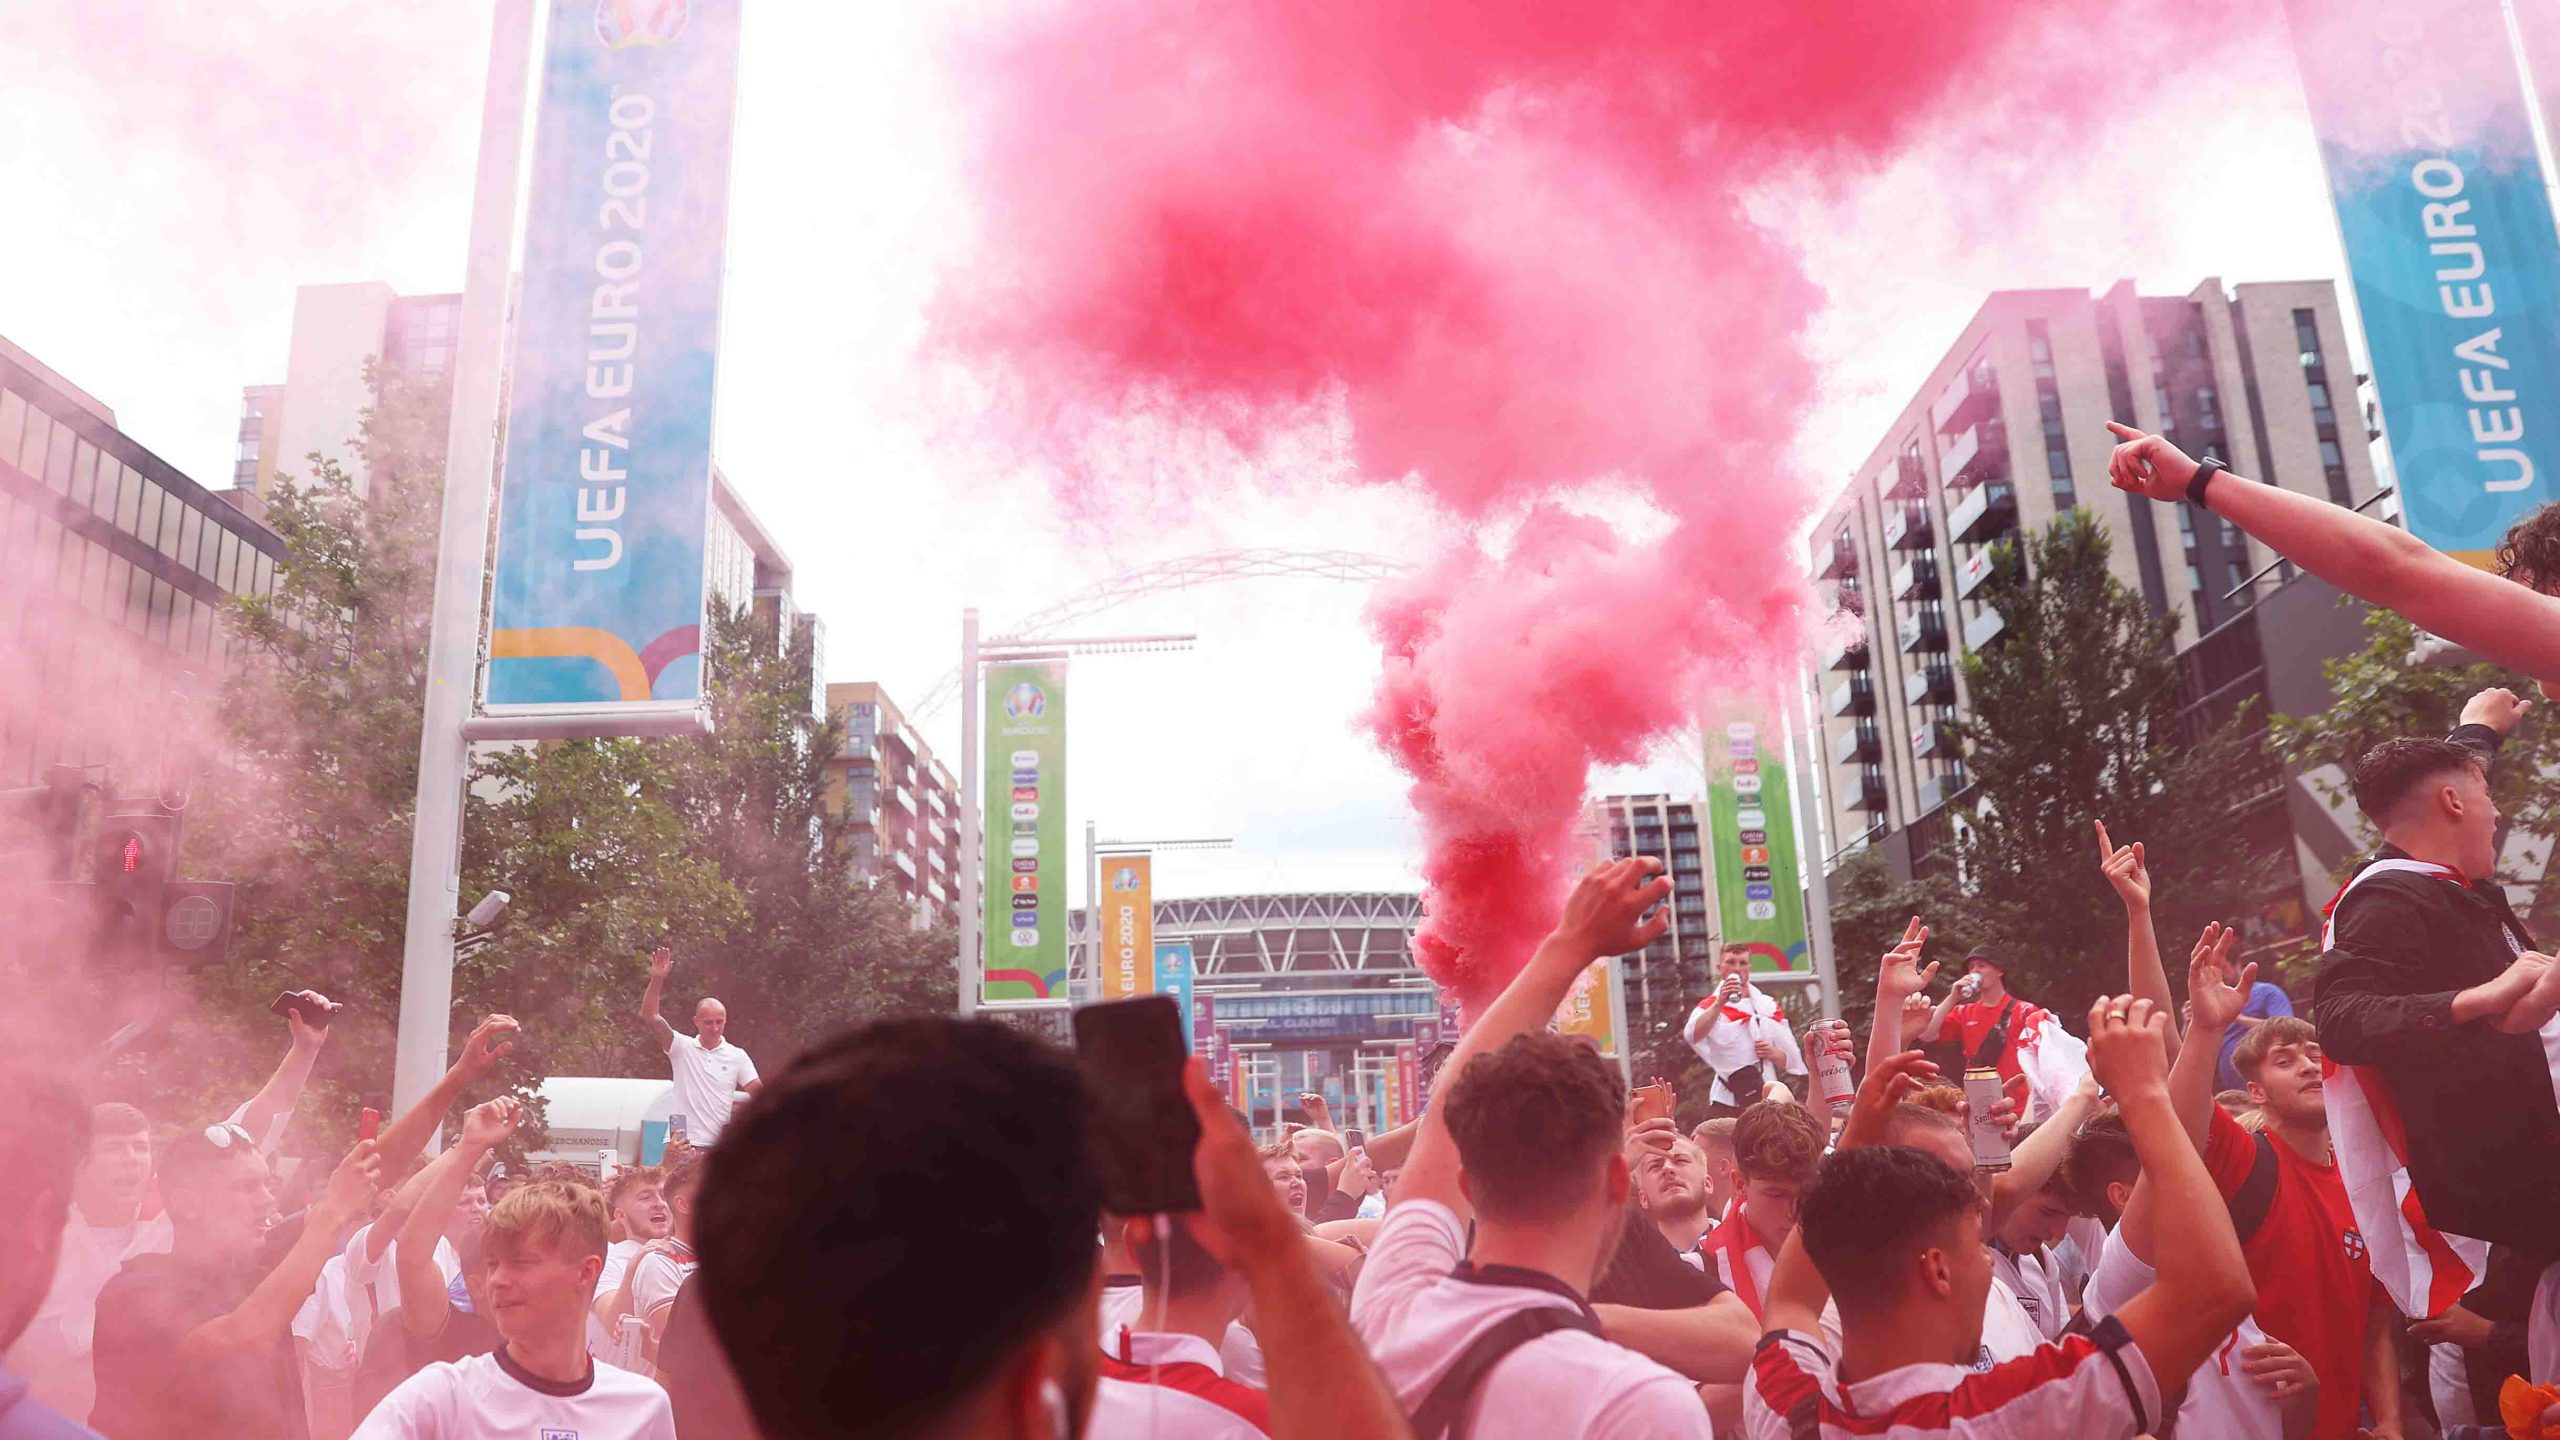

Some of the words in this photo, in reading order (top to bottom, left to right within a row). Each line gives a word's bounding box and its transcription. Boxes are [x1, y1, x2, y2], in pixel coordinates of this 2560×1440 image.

[599, 93, 655, 229] 2020
[2412, 158, 2496, 318] EURO
[586, 239, 642, 398] EURO
[2454, 327, 2535, 492] UEFA
[573, 407, 630, 571] UEFA
[1120, 905, 1135, 945] 2020
[1120, 948, 1135, 991] EURO
[1821, 1064, 1848, 1078] weiser
[551, 1137, 609, 1146] ERCHANDISE
